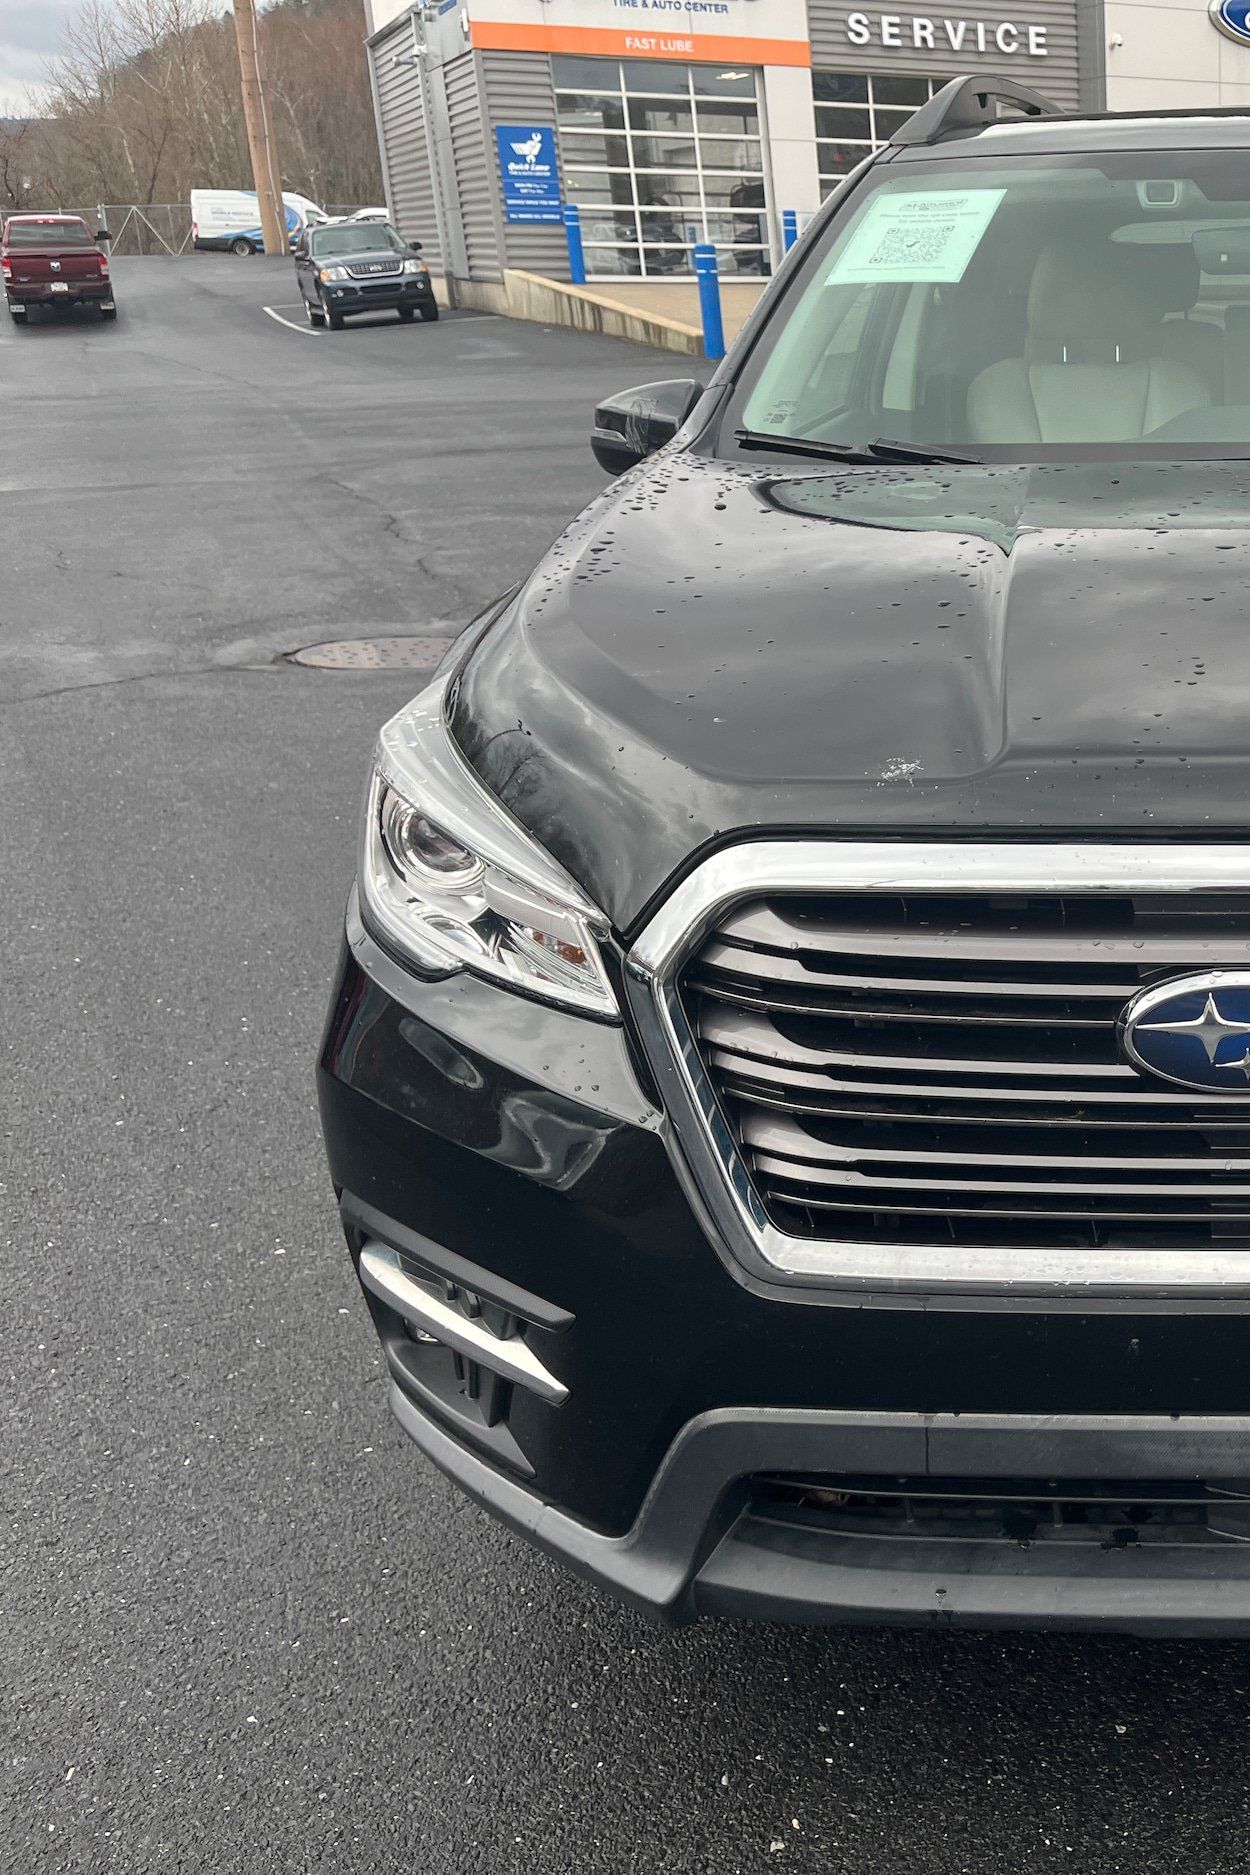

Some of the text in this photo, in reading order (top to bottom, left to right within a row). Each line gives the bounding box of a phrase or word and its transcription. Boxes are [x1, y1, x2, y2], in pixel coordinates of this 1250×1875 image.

[651, 0, 682, 10] AUTO
[684, 2, 729, 13] CENTER
[847, 12, 1048, 56] SERVICE
[624, 36, 694, 52] FAST LUBE
